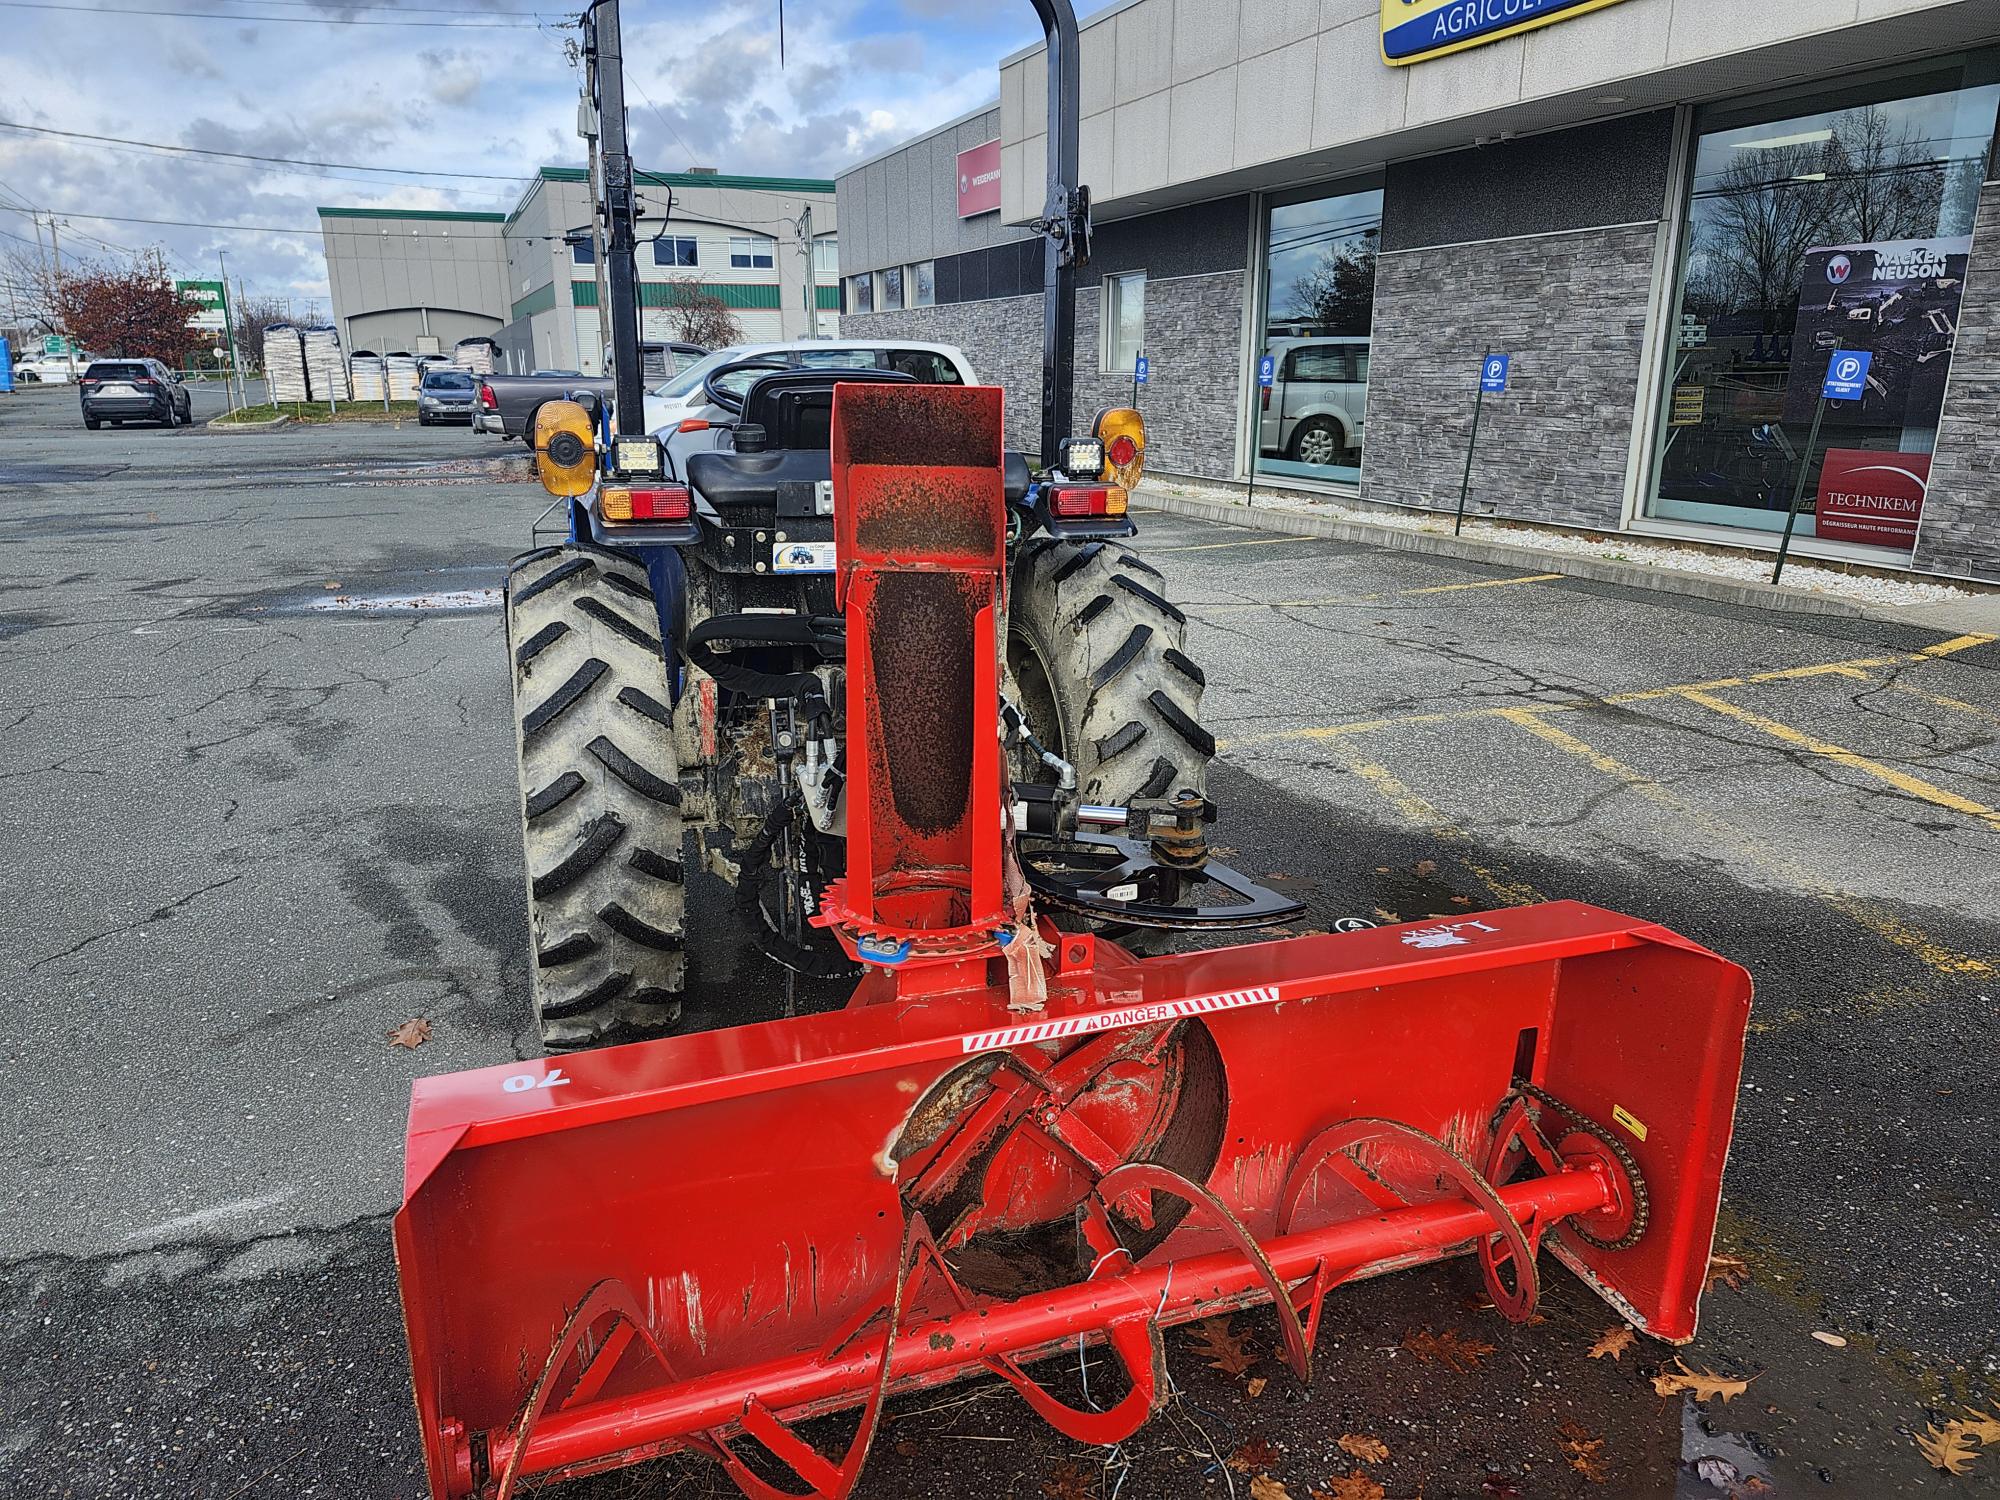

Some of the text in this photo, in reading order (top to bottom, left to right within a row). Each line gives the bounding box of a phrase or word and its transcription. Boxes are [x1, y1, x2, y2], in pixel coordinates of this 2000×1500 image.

[1874, 250, 1948, 266] WACKER
[1872, 262, 1947, 281] NEUSON
[1827, 492, 1918, 512] TECHNIKEM
[1822, 520, 1858, 529] DÉGRAISSEUR
[1858, 524, 1877, 532] HAUTE
[1100, 1006, 1168, 1028] DANGER
[502, 1068, 571, 1093] 70
